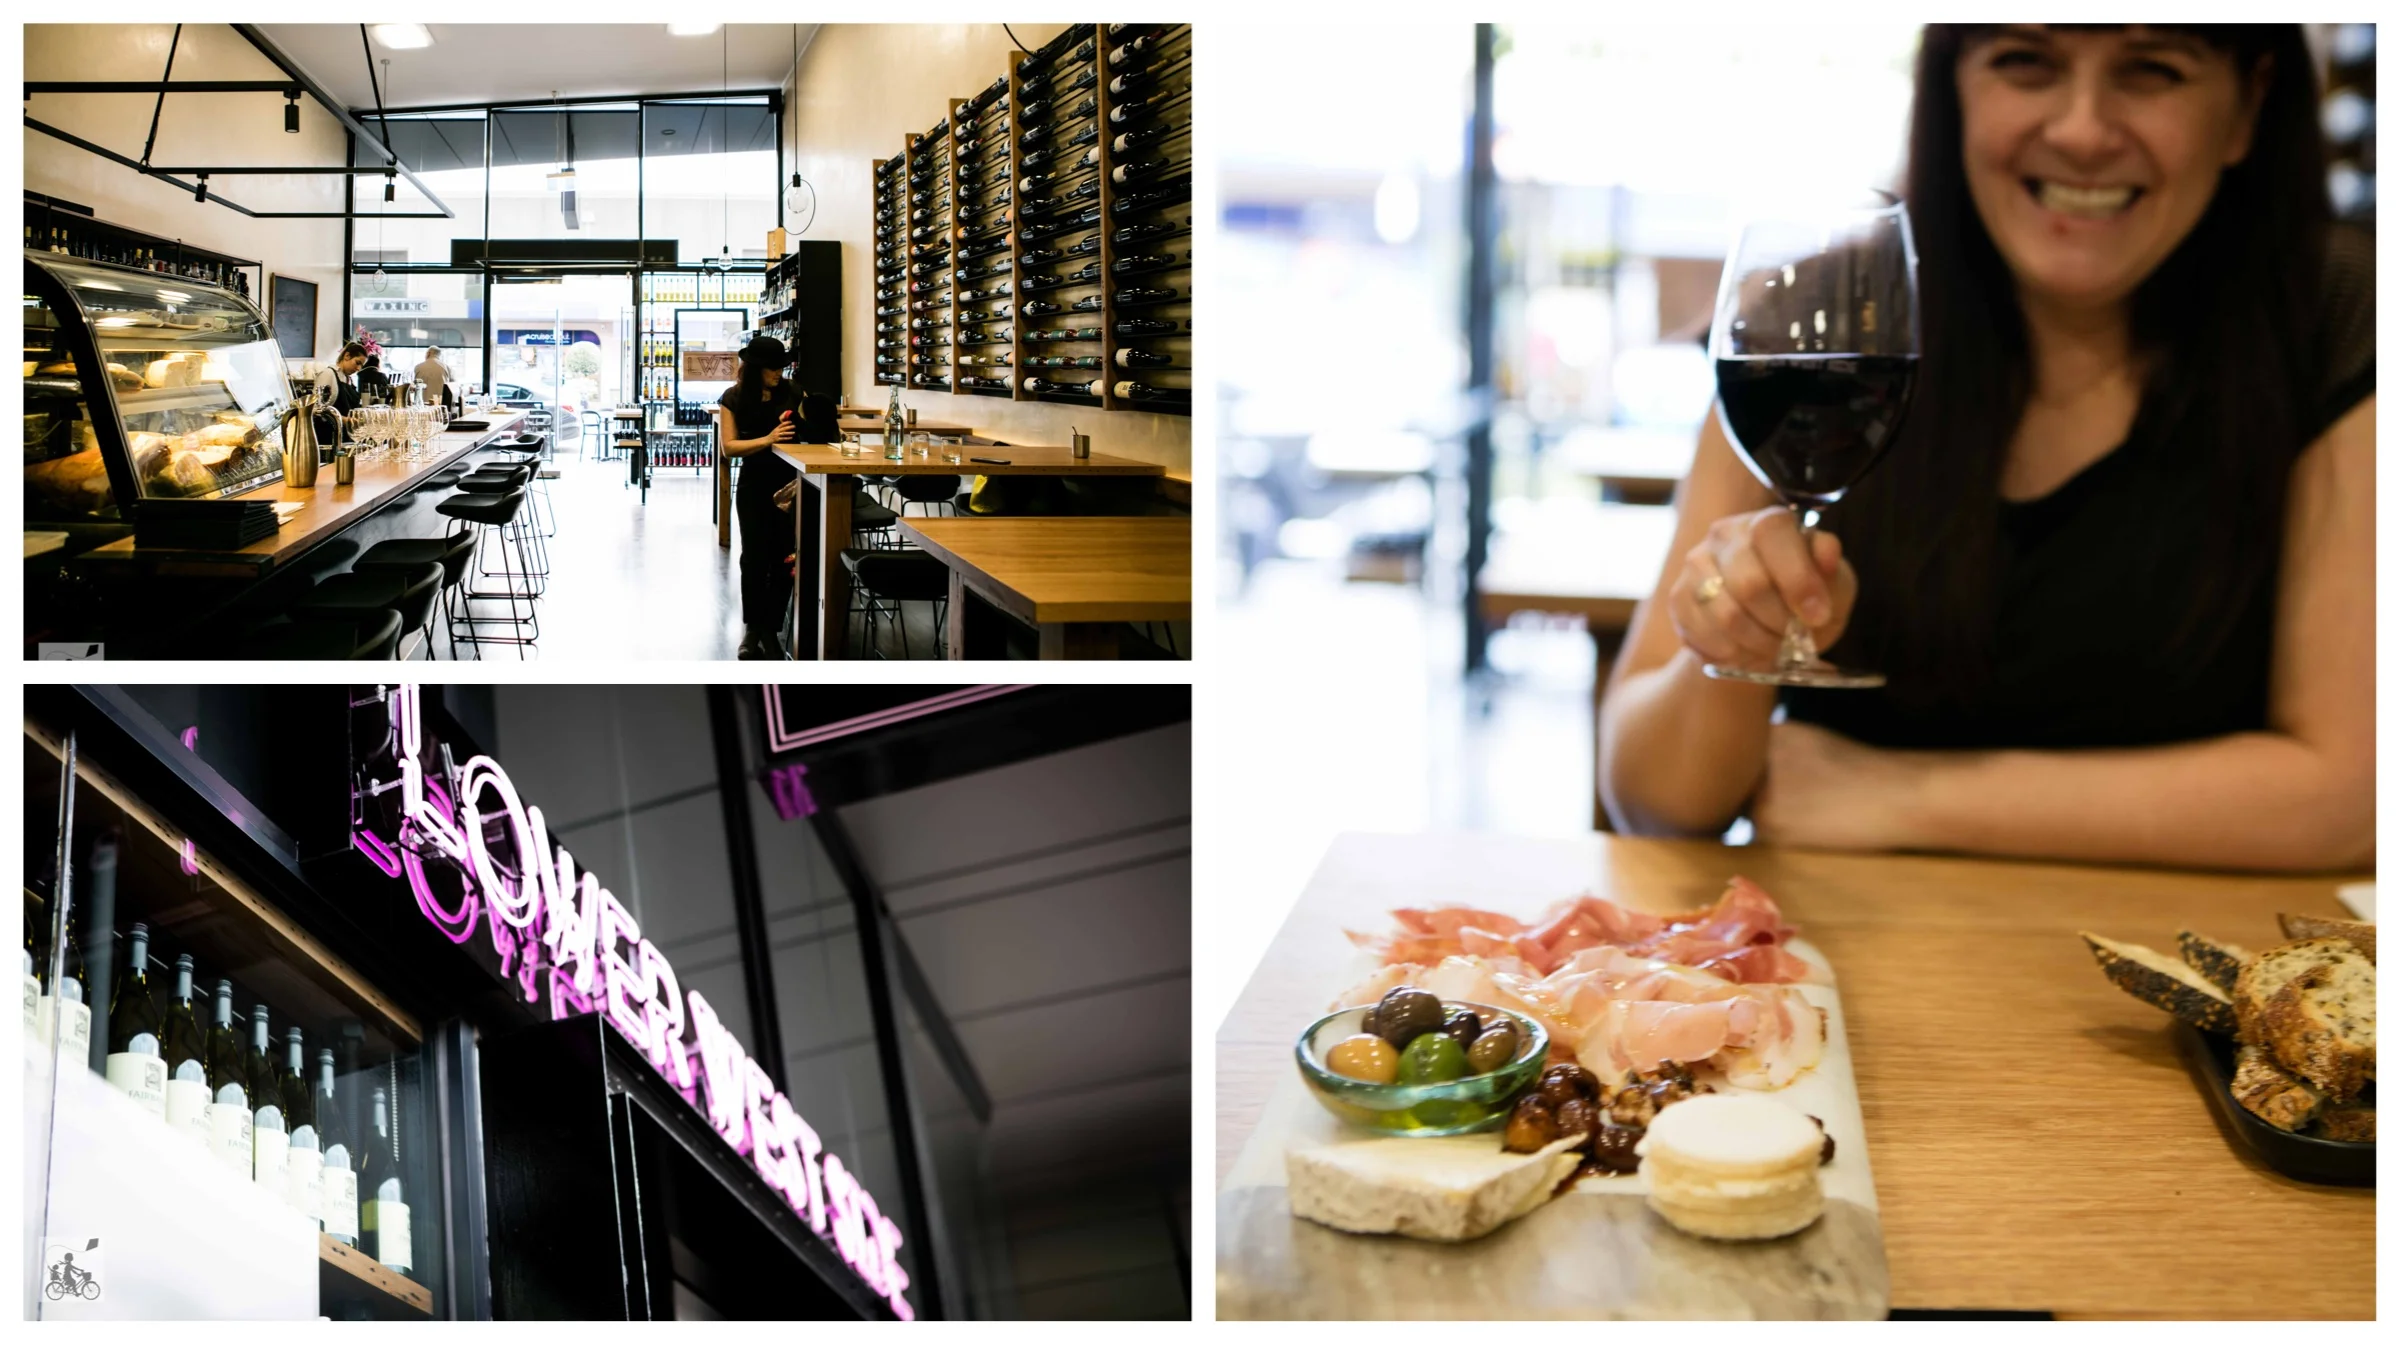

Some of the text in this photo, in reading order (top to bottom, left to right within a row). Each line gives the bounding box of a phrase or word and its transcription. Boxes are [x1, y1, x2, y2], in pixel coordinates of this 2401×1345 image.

[364, 302, 428, 312] WAXING
[687, 354, 735, 376] LWS
[398, 684, 693, 1089] LOWER
[688, 990, 827, 1233] WEST
